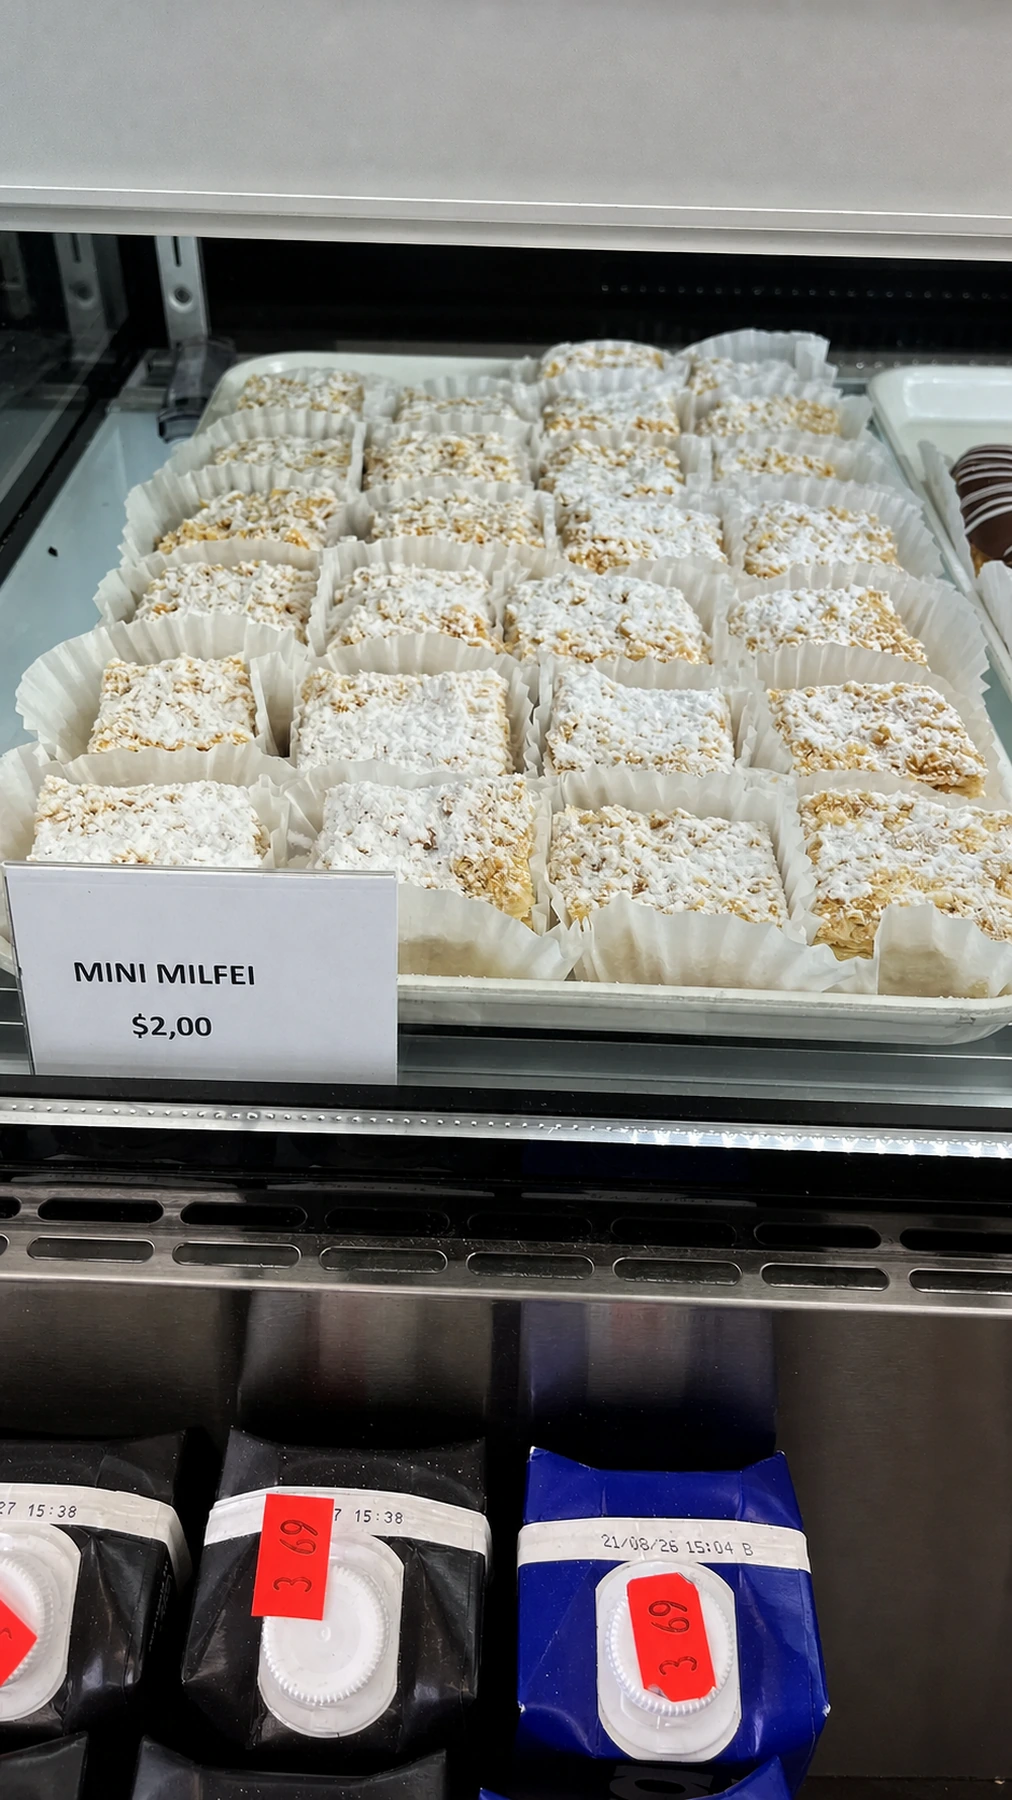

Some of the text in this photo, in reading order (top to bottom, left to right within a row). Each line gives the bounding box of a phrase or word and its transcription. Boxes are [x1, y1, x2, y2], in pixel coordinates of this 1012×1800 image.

[73, 962, 255, 985] MINI MILFEI
[132, 1013, 212, 1040] $2,00
[28, 1504, 77, 1518] 15:38
[355, 1509, 403, 1524] 15:38
[601, 1533, 754, 1556] 21/08/26 15:04 B
[273, 1577, 312, 1592] 3
[659, 1656, 697, 1675] 3
